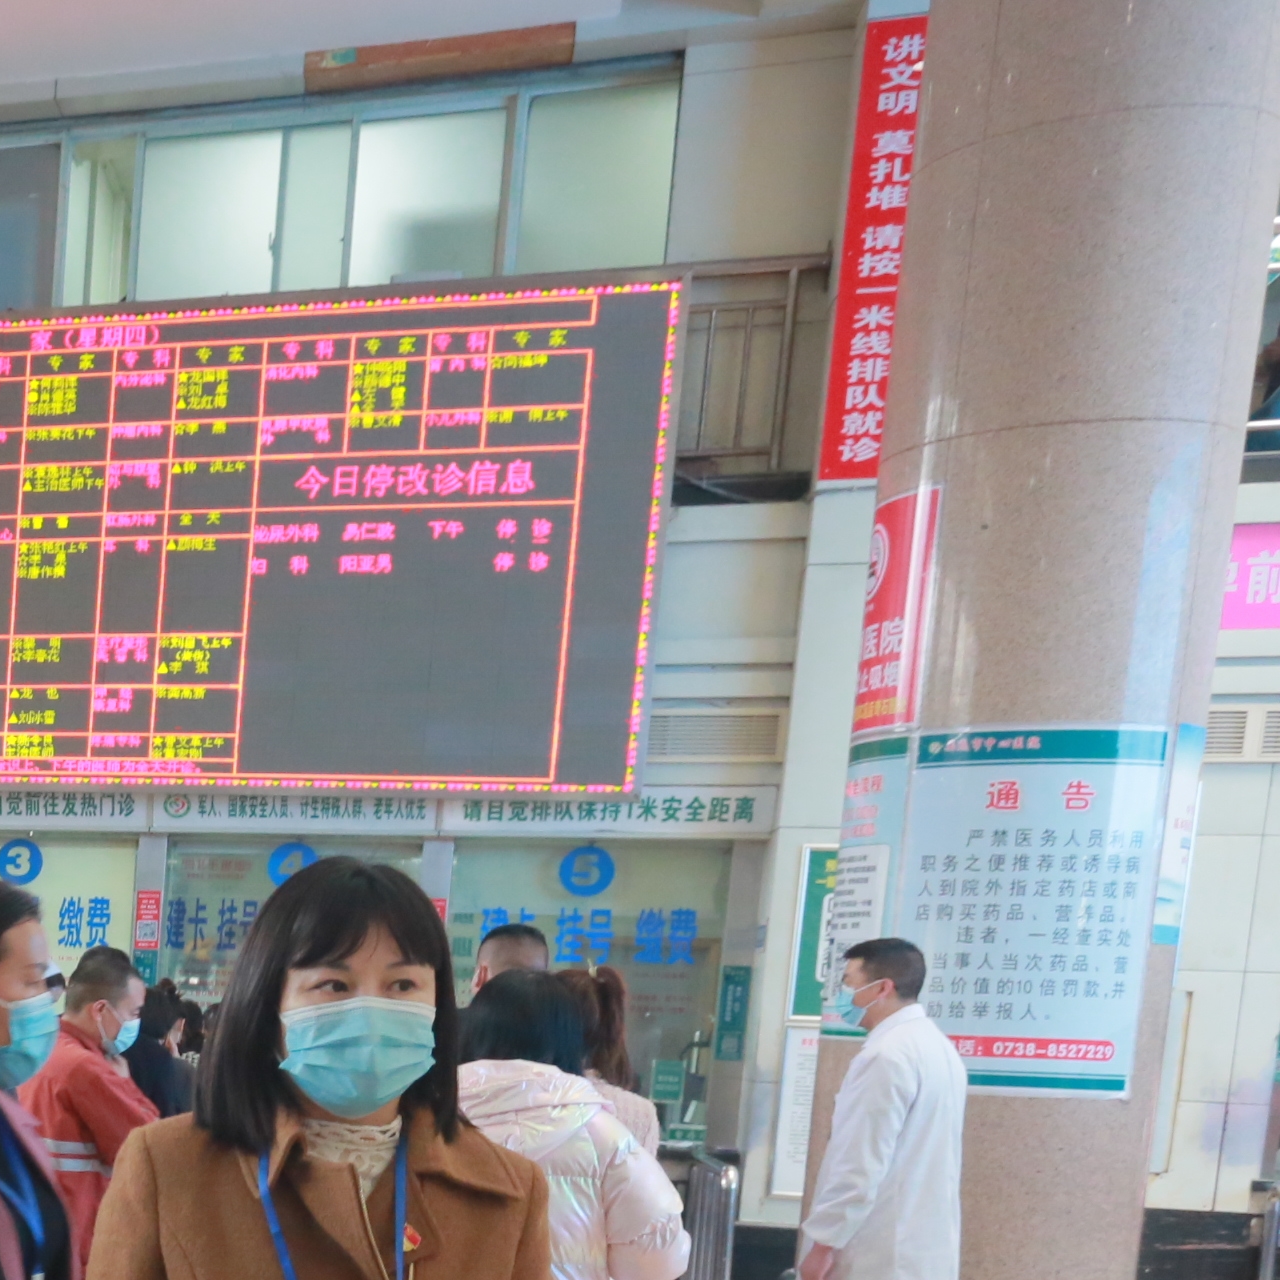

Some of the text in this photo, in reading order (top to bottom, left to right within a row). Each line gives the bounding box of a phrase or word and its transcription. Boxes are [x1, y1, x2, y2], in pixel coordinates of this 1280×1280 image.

[838, 35, 926, 463] 讲文明 莫扎堆 请按一米线排队就诊
[295, 458, 536, 498] 今日停改诊信息
[179, 511, 221, 526] 全天
[428, 520, 464, 539] 下午
[496, 518, 553, 543] 停诊
[252, 522, 319, 543] 泌尿外科
[250, 555, 308, 576] 妇科
[493, 551, 551, 573] 停诊
[985, 779, 1096, 812] 通告
[965, 828, 1145, 848] 严禁医务人员利用
[5, 846, 32, 877] 3
[278, 851, 304, 875] 4
[570, 853, 602, 887] 5
[920, 854, 1140, 875] 职务之便推荐或诱导病
[918, 879, 1137, 900] 人到院外指定药店或商
[57, 895, 111, 949] 缴费
[166, 896, 208, 950] 建卡
[553, 908, 615, 963] 挂号
[633, 908, 698, 965] 缴费
